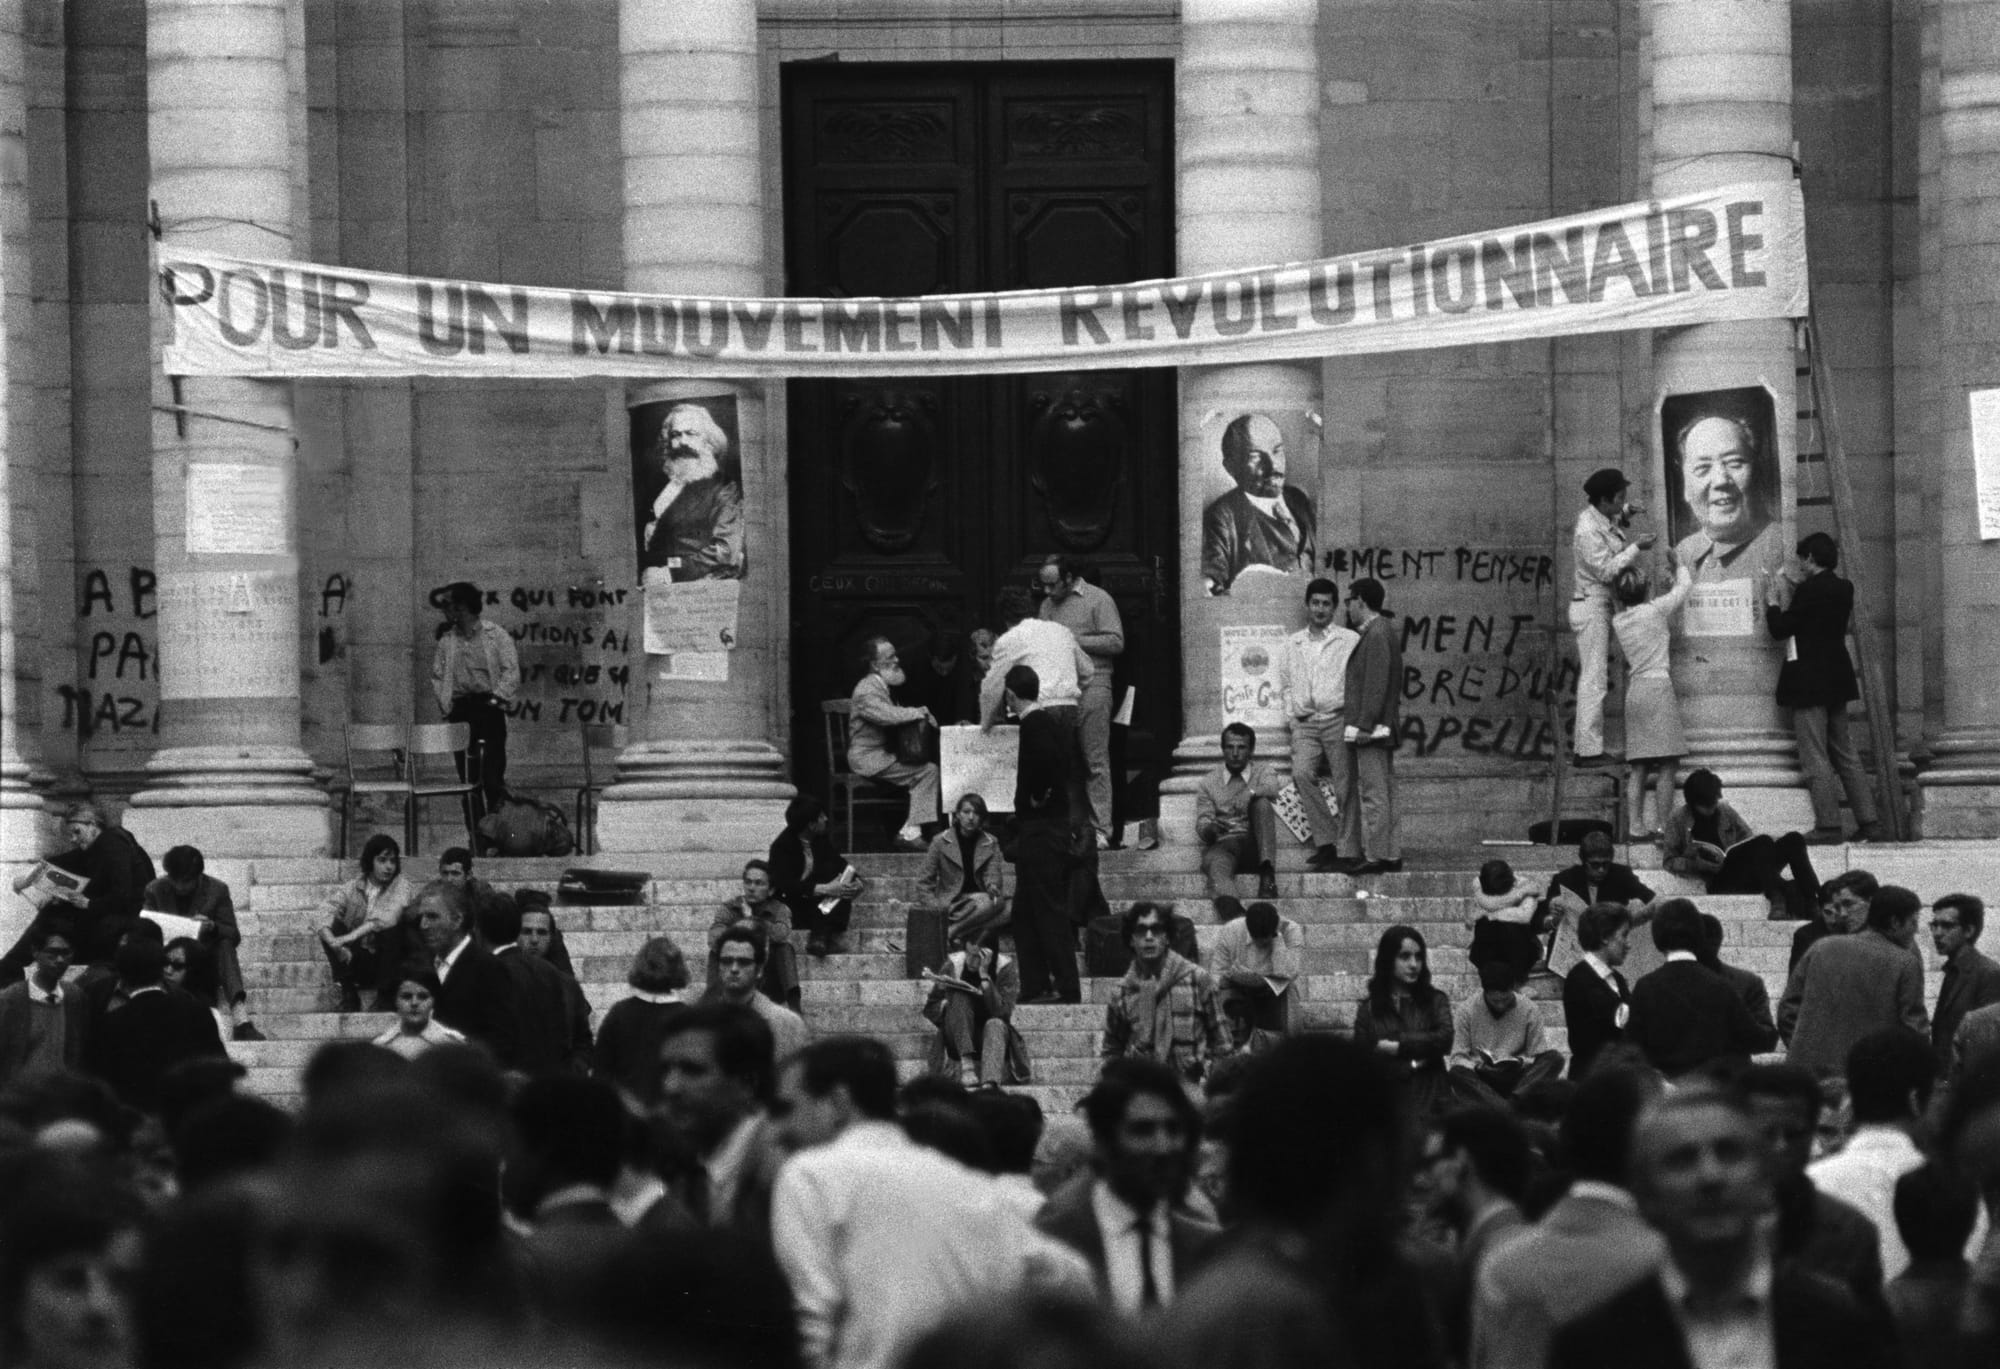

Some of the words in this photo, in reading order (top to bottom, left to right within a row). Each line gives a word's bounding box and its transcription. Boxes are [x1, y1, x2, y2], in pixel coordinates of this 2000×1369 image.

[160, 262, 378, 351] POUR
[417, 282, 530, 357] UN
[570, 293, 1002, 357] MOUVEMENT
[1059, 200, 1767, 346] REVOLUTIONNAIRE
[1455, 547, 1554, 584] PENSER
[82, 569, 114, 617] A
[511, 587, 554, 612] QUI
[568, 587, 628, 609] FONT
[510, 622, 594, 648] UTIONS
